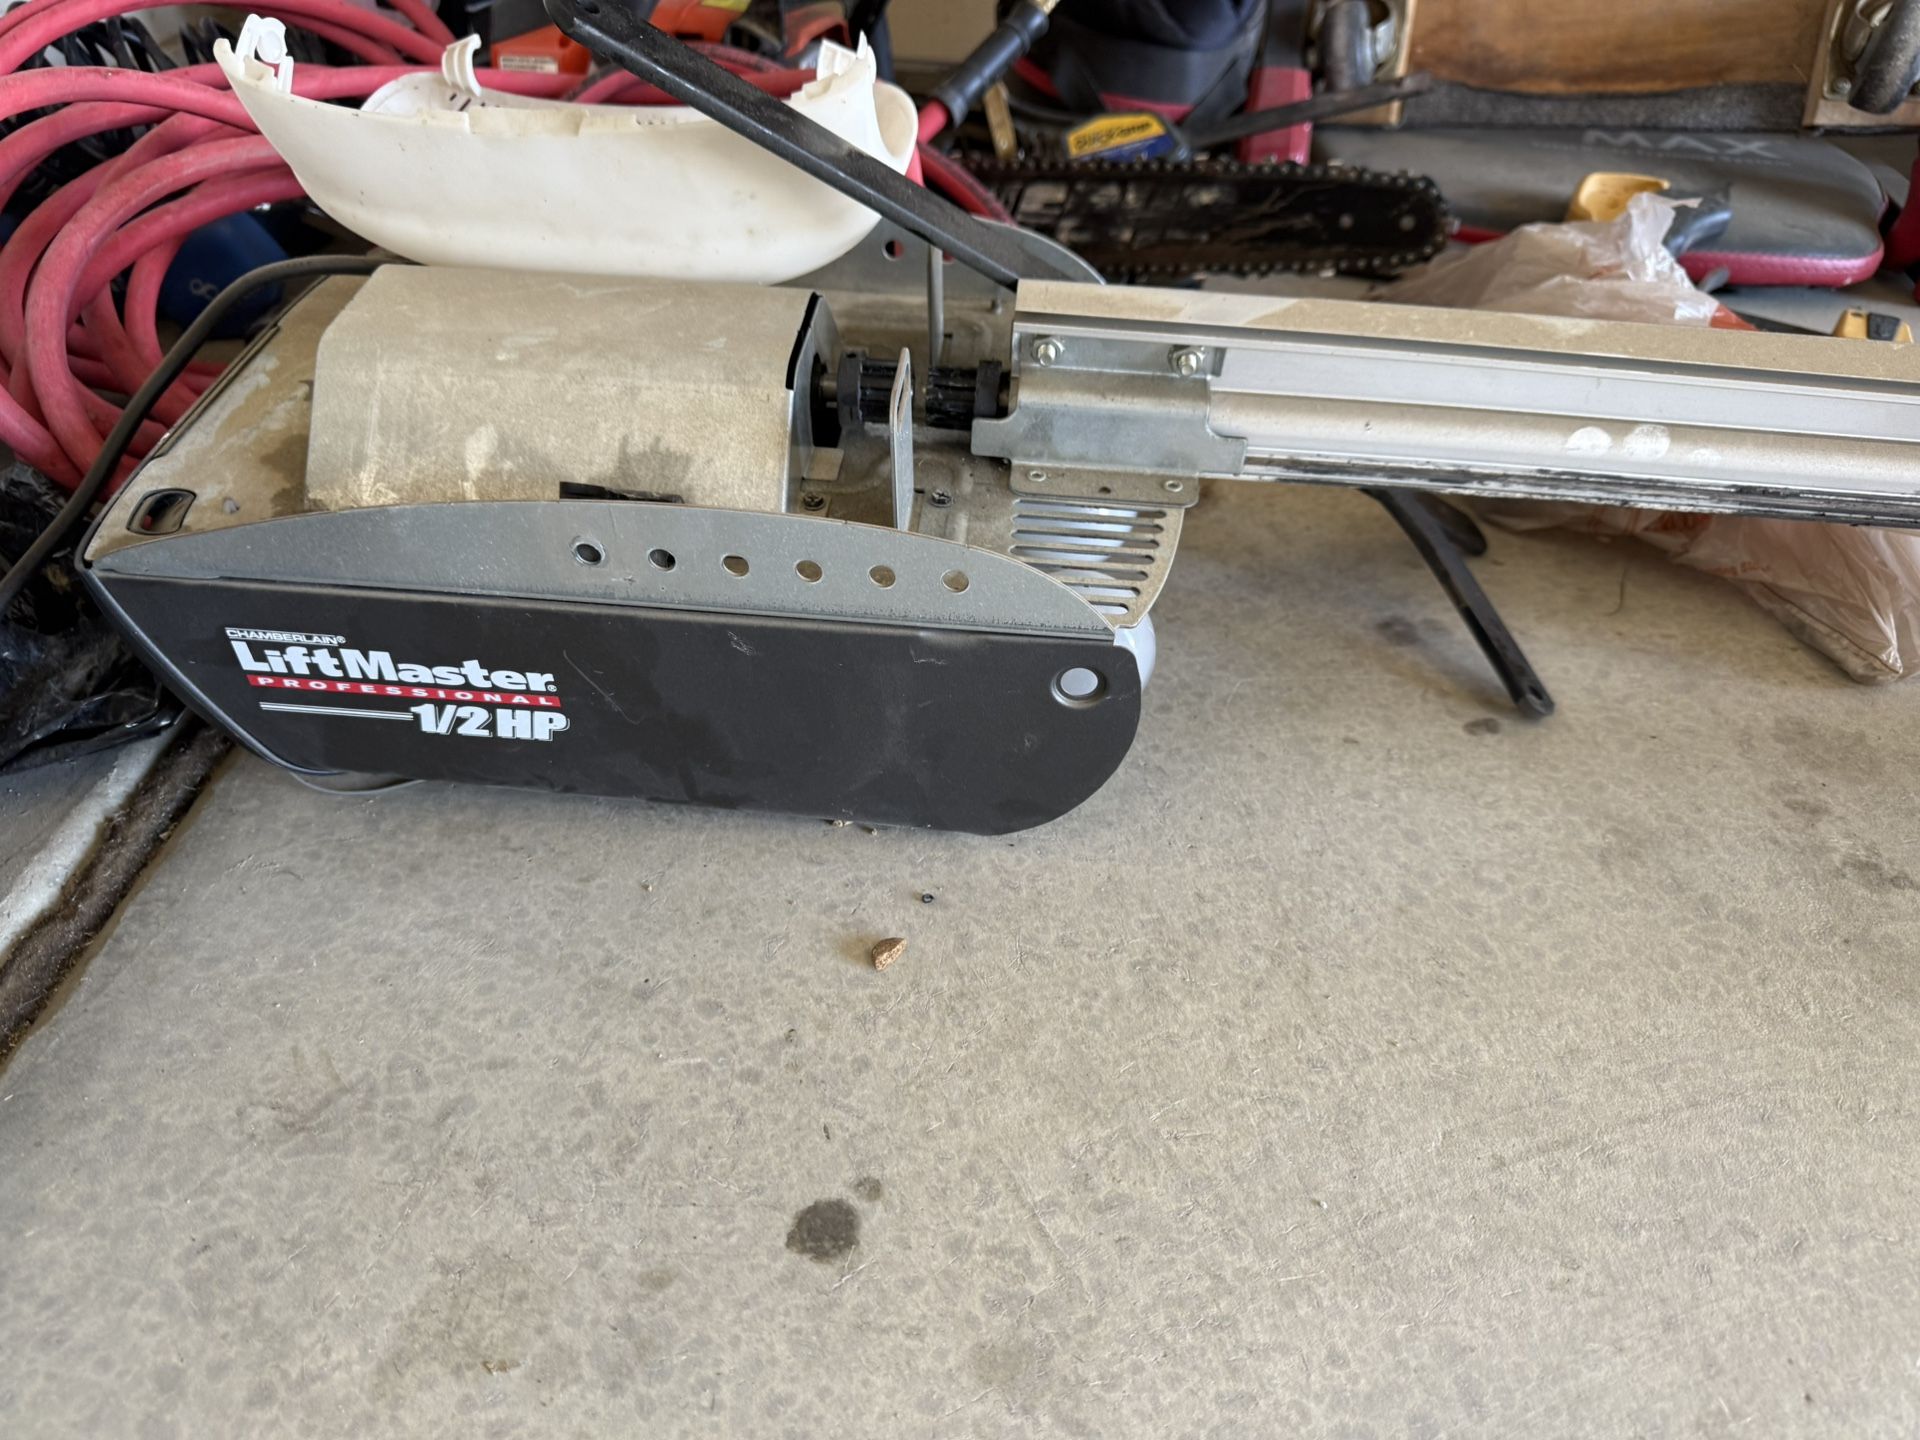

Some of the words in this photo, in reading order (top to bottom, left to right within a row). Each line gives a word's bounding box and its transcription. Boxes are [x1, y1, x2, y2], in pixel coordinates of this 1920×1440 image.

[1583, 129, 1782, 159] MAX
[257, 677, 554, 706] PROFESSIONAL
[410, 703, 493, 738] 1/2
[496, 708, 571, 742] HP
